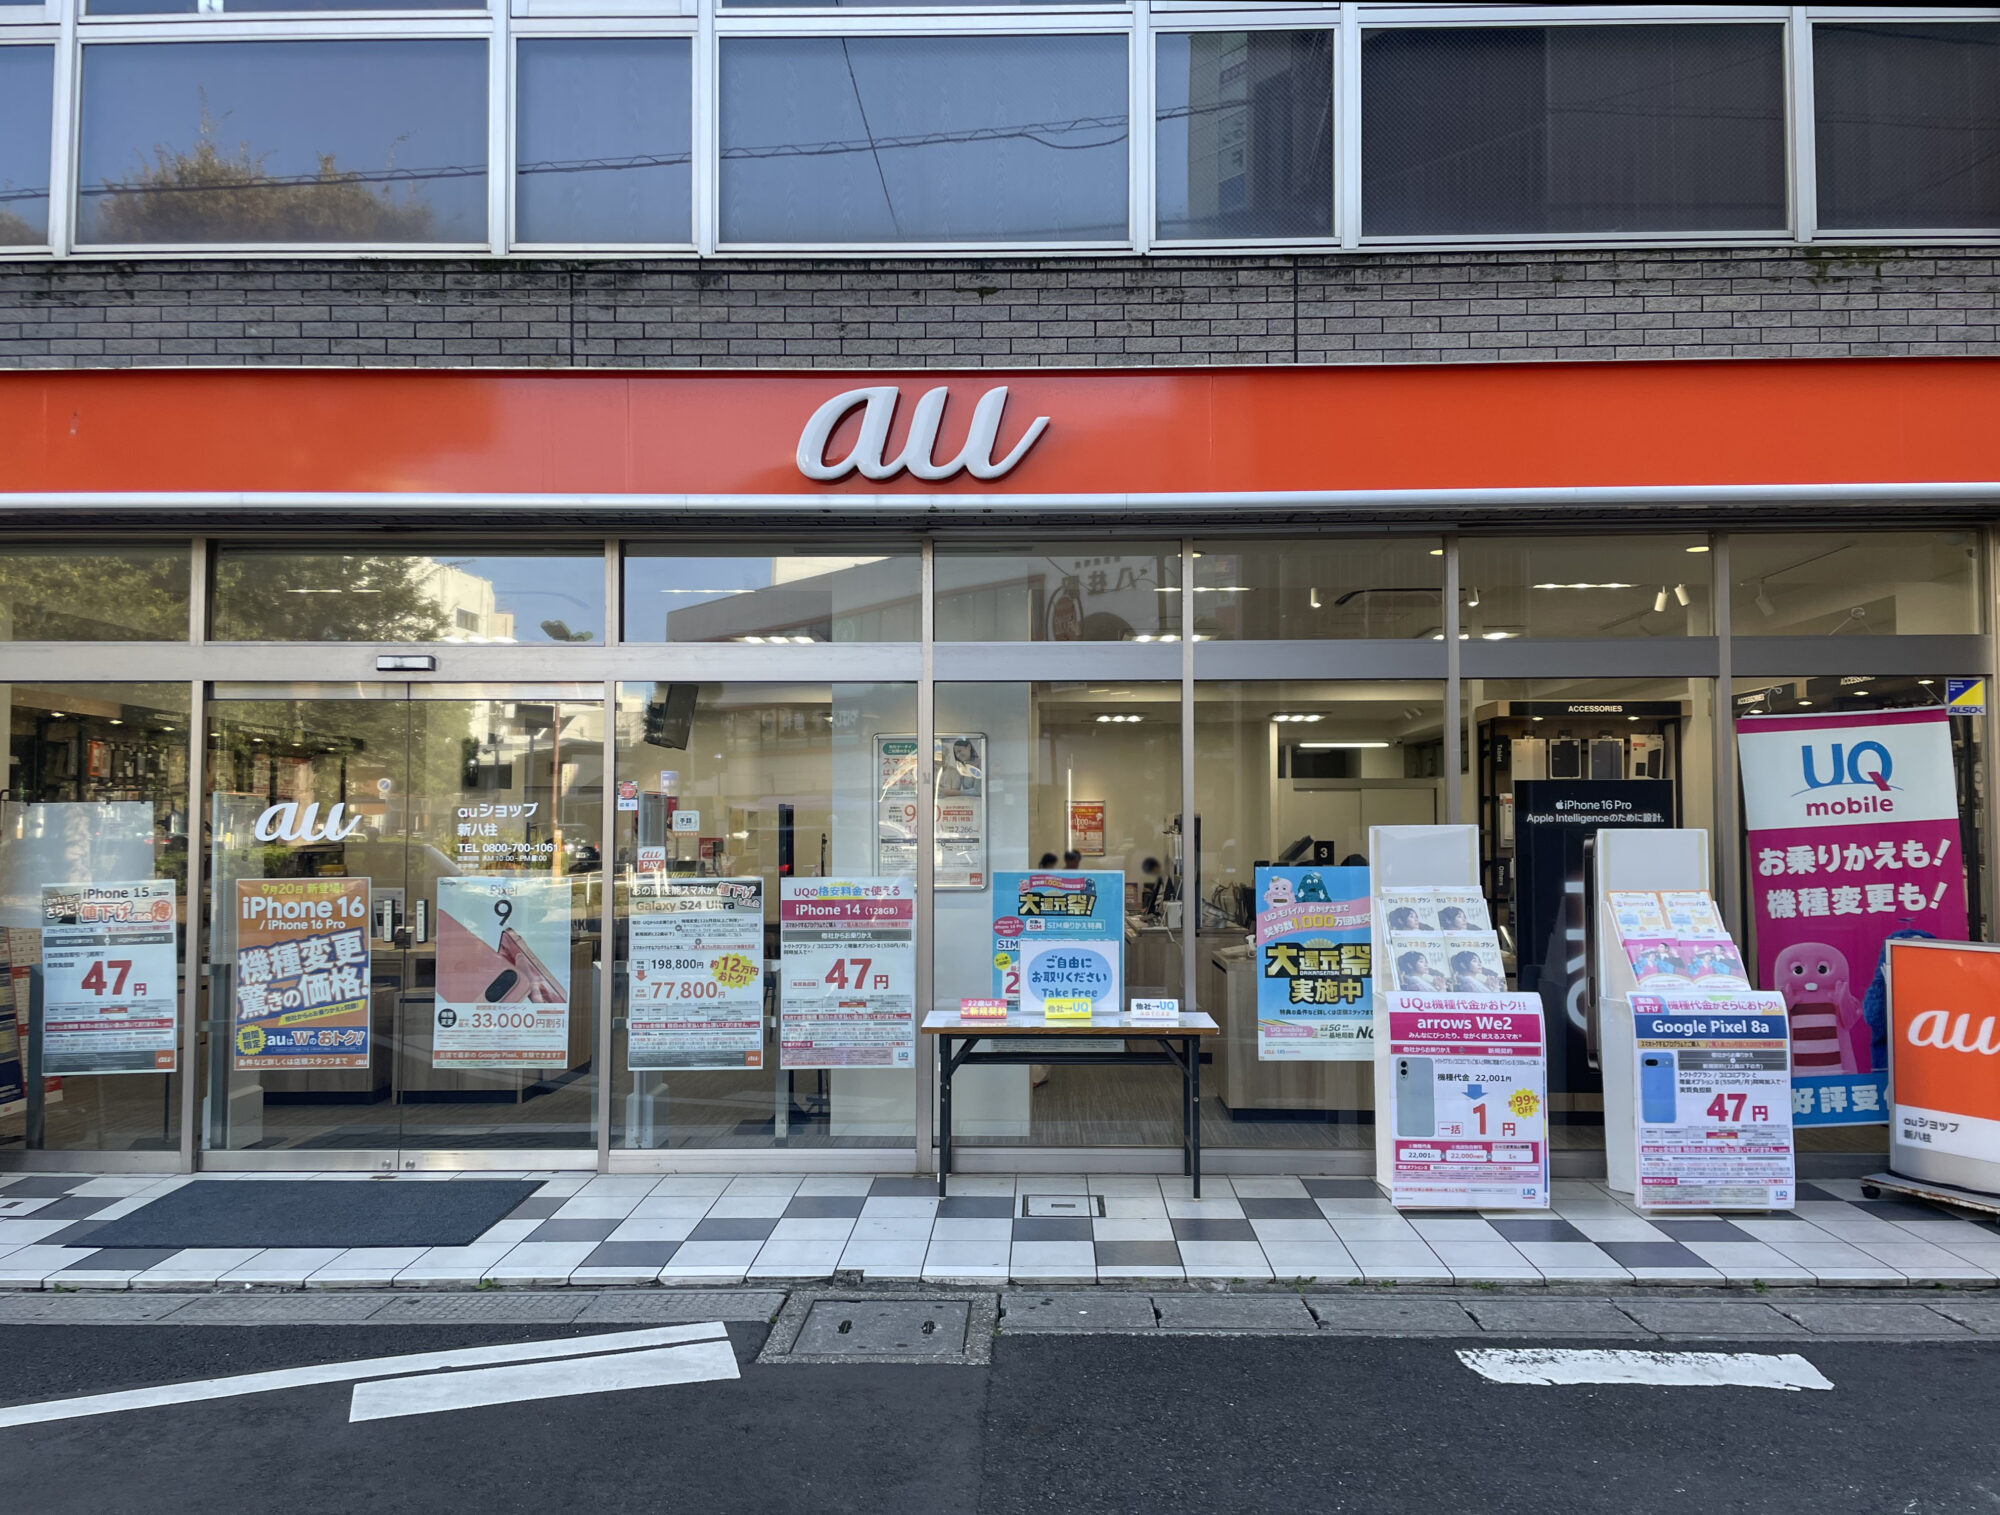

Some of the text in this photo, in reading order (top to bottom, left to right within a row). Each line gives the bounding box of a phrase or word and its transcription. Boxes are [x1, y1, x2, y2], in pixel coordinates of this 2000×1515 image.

[796, 386, 1050, 480] au
[1801, 741, 1893, 791] UQ
[458, 802, 538, 818] auショップ
[1564, 800, 1632, 810] iPhone 16 Pro
[1806, 796, 1893, 816] mobile
[255, 802, 362, 841] au
[1527, 814, 1554, 824] Apple
[457, 823, 498, 836] 新八柱
[458, 844, 558, 852] TEL 0800-700-1061
[1320, 848, 1327, 858] 3
[1758, 838, 1951, 877] お乗りかえも!
[83, 887, 149, 900] iPhone 15
[261, 883, 344, 893] 9月20日 新登場!
[490, 885, 518, 895] Pixel
[794, 886, 900, 897] UQの格安料金で使える
[242, 896, 365, 919] iPhone 16
[636, 900, 735, 912] Galaxy S24 Ultra
[1020, 894, 1095, 915] 大還元祭!
[1767, 882, 1948, 919] 機種変更も!
[46, 903, 80, 918] さらに!
[494, 900, 512, 926] 9
[795, 904, 841, 916] iPhone
[845, 904, 860, 915] 14
[1278, 907, 1305, 916] モバイル
[268, 920, 307, 929] iPhone
[311, 920, 322, 929] 16
[326, 920, 346, 929] Pro
[239, 931, 366, 984] 機種変更
[651, 959, 704, 970] 198,800円
[1046, 956, 1092, 968] ご自由に
[825, 959, 888, 990] 47円
[1032, 972, 1107, 982] お取りください
[238, 966, 369, 1019] 驚きの価格!
[651, 981, 725, 1000] 77,800円
[1042, 988, 1098, 997] Take Free
[1291, 979, 1362, 1003] 実施中
[1073, 1002, 1088, 1012] UQ
[1160, 1001, 1175, 1010] UQ
[1400, 997, 1527, 1011] UQは機種代金がおトク!!
[1668, 1000, 1777, 1010] 機種代金がさらにおトク!
[472, 1013, 564, 1029] 33,000円割引
[1418, 1017, 1512, 1030] arrows We2
[1652, 1020, 1769, 1036] Google Pixel 8a
[1908, 1010, 2000, 1055] au
[1791, 1085, 1889, 1114] 好評受
[1518, 1105, 1533, 1114] OFF
[1707, 1093, 1768, 1122] 47円
[1441, 1125, 1460, 1134] 一括
[1904, 1118, 1959, 1132] auショップ
[1904, 1129, 1932, 1143] 新八柱
